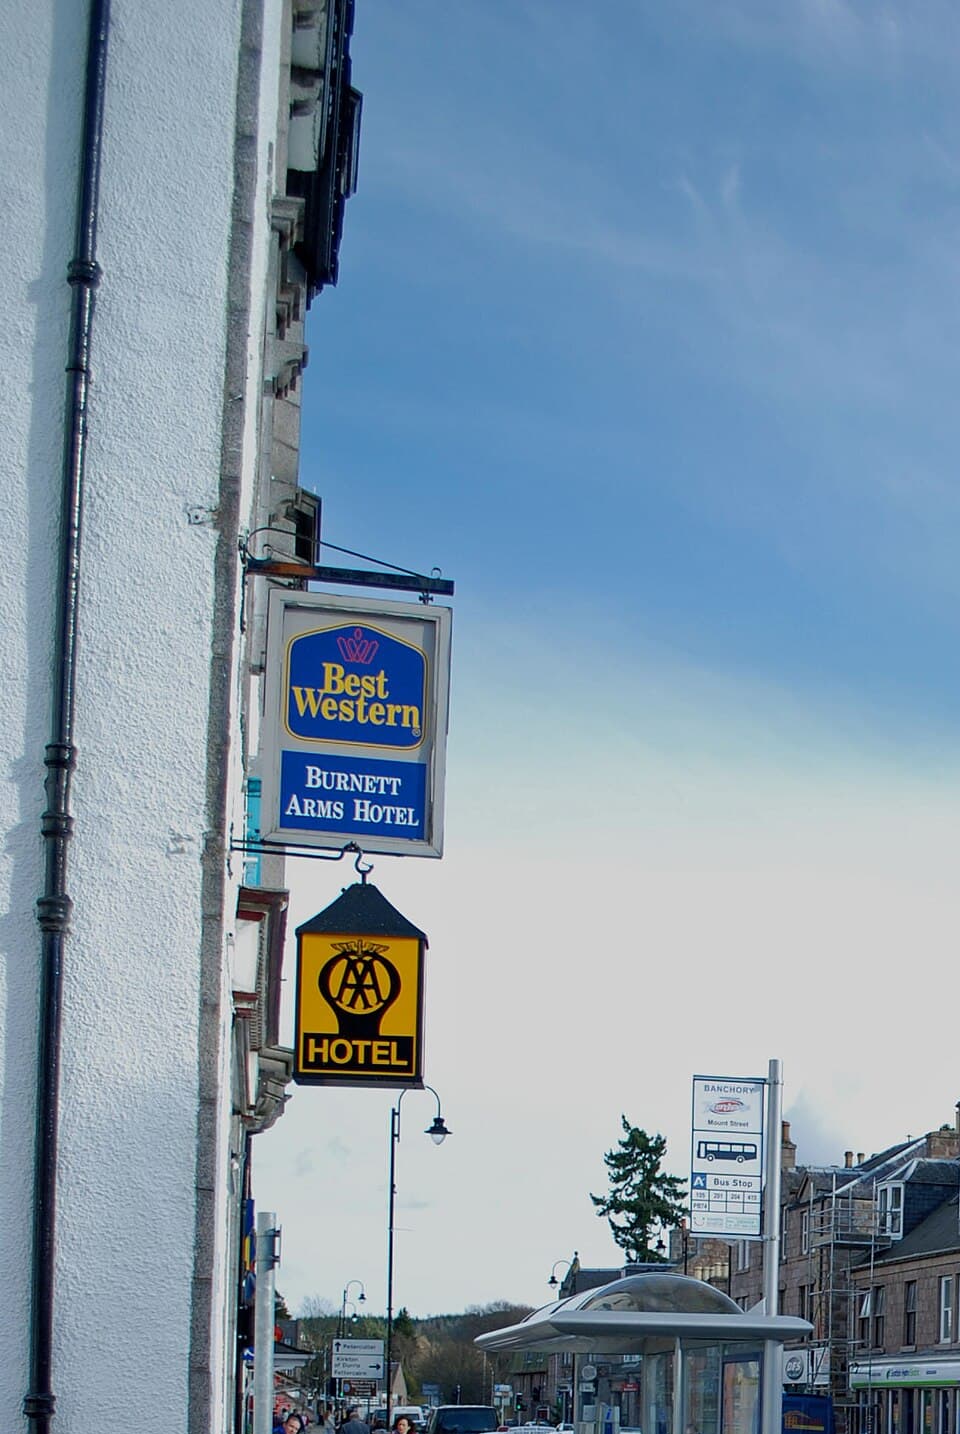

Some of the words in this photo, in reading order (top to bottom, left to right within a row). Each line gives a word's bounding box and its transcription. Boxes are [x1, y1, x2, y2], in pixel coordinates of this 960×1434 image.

[322, 662, 389, 700] Best
[292, 687, 421, 728] Western
[305, 765, 402, 795] BURNETT
[285, 793, 344, 820] ARMS
[353, 798, 419, 826] HOTEL
[335, 958, 384, 1009] AA
[307, 1037, 409, 1067] HOTEL
[704, 1084, 754, 1094] BANCHORY
[708, 1119, 728, 1127] Mount
[729, 1120, 749, 1128] Street
[713, 1178, 729, 1187] Bus
[732, 1179, 753, 1189] Stop
